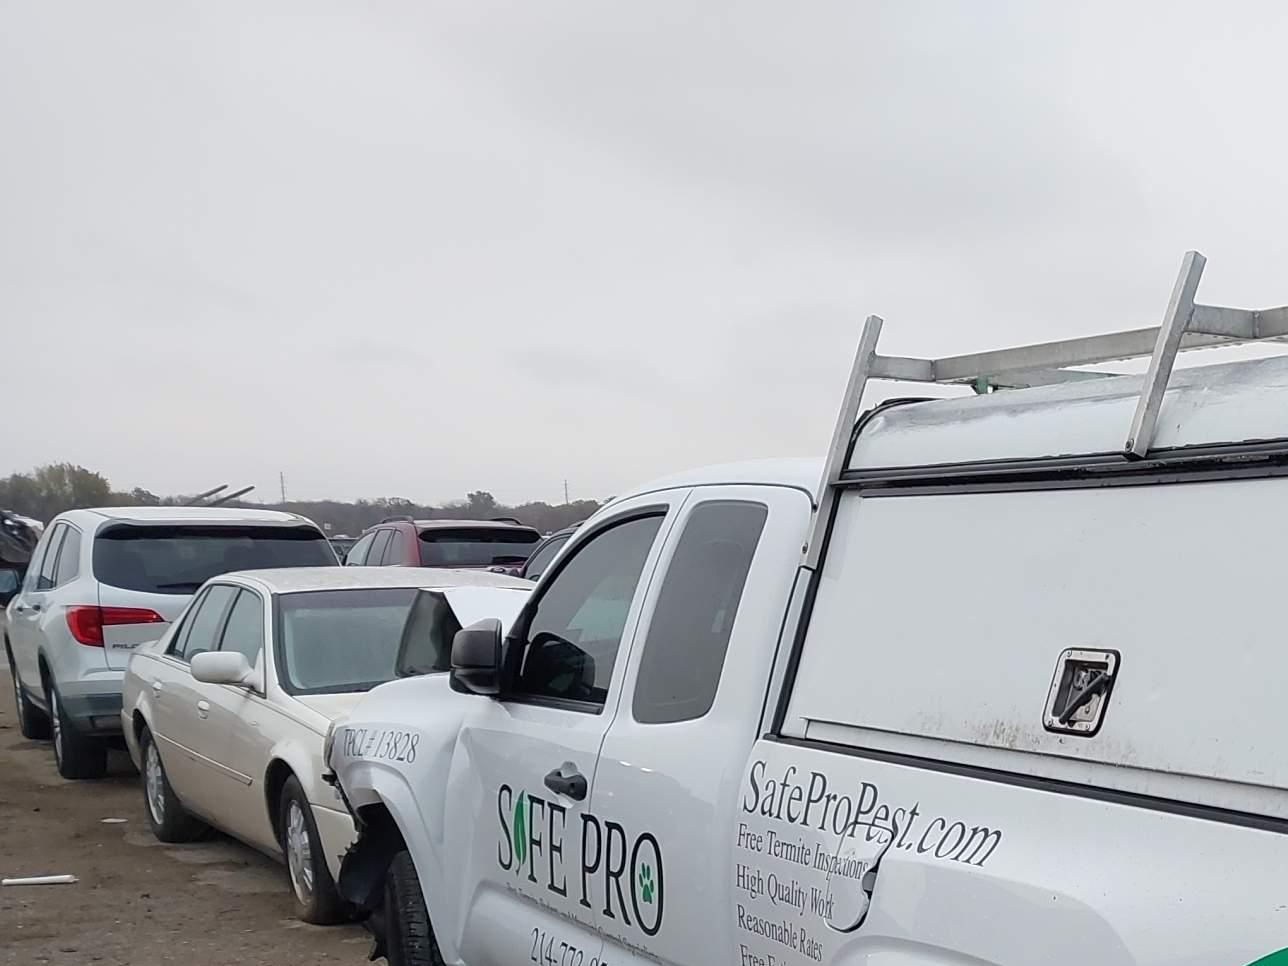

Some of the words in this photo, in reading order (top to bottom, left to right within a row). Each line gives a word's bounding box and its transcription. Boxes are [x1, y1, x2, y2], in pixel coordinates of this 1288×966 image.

[737, 823, 763, 852] Free
[767, 830, 811, 867] Termite
[580, 813, 664, 936] PRO
[736, 864, 764, 899] High
[767, 873, 808, 916] Quality
[811, 887, 835, 920] Work
[736, 903, 798, 950] Reasonable
[799, 927, 823, 962] Rates
